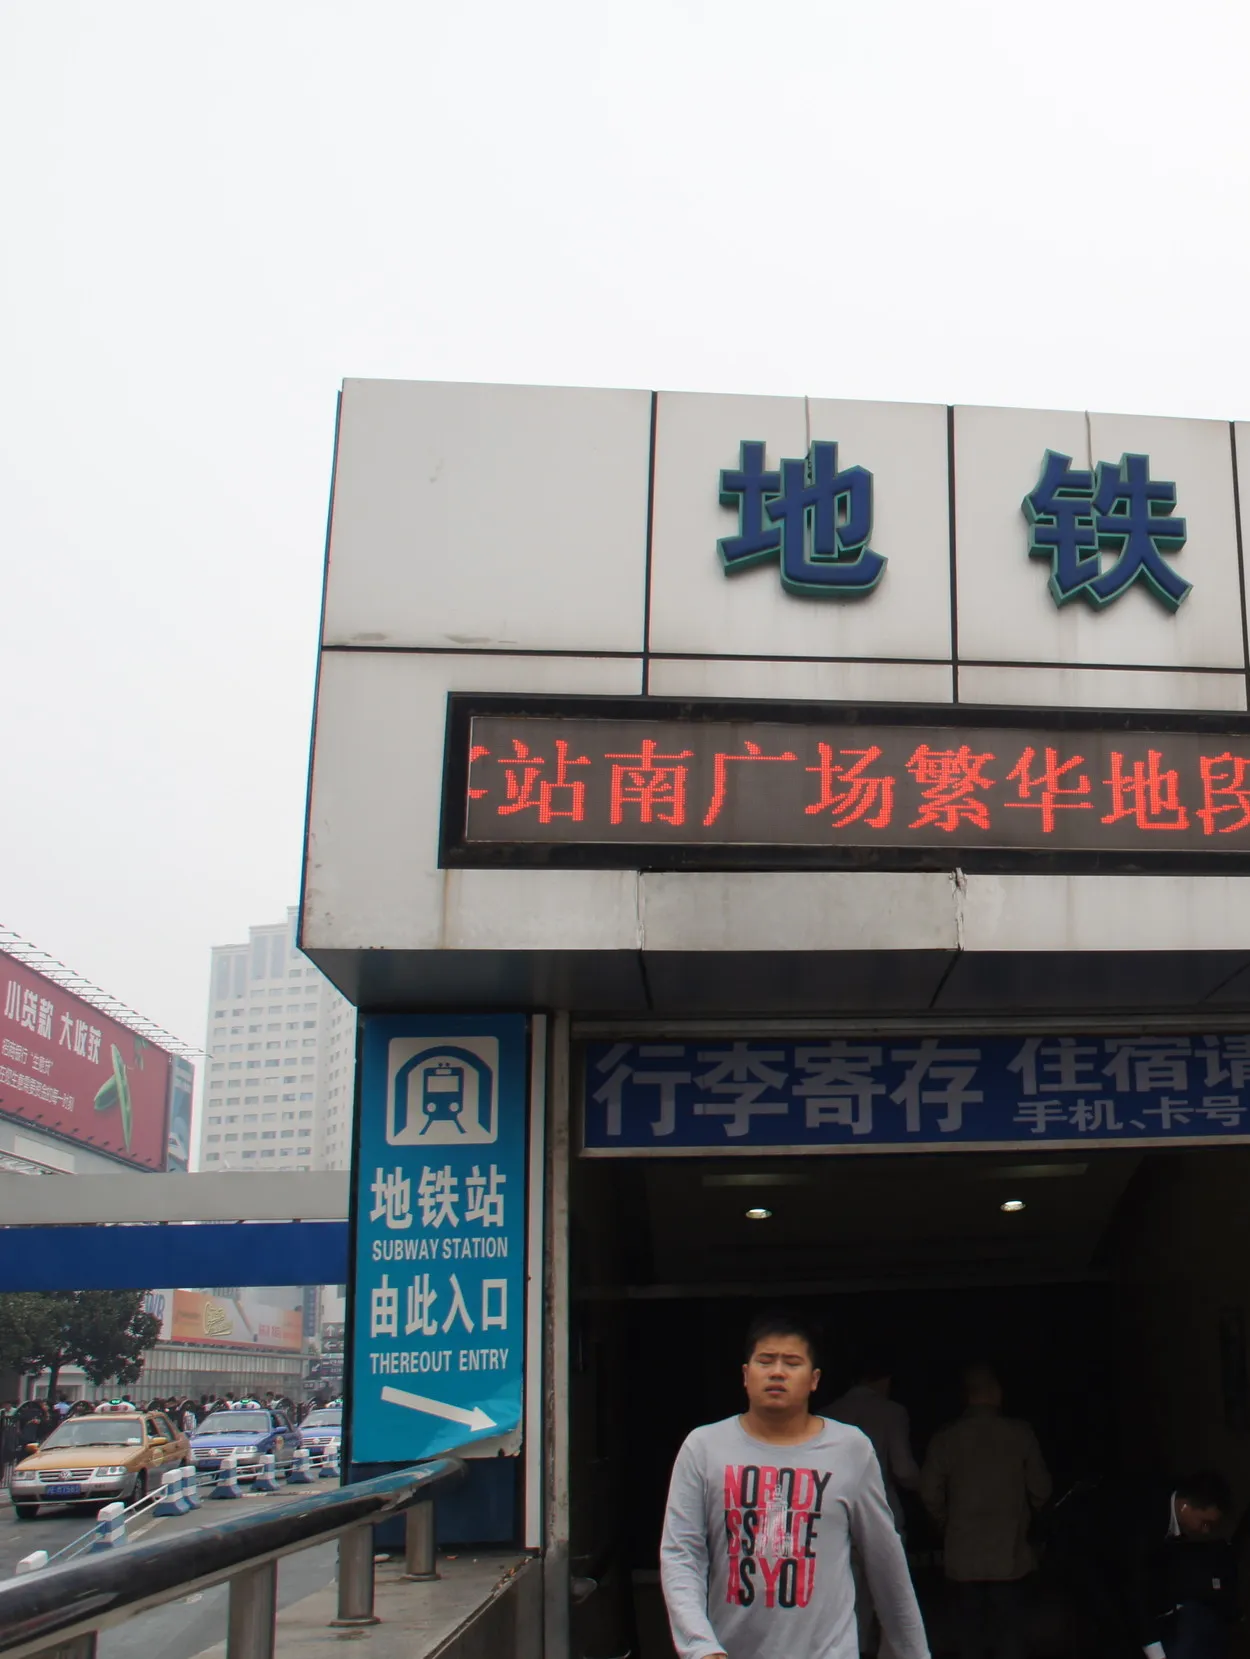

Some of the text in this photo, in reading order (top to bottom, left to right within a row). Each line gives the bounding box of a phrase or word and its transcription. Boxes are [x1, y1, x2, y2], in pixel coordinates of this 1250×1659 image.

[592, 1040, 983, 1137] 行李寄存
[370, 1164, 507, 1229] 地铁站
[372, 1236, 508, 1261] SUBWAY STATION
[370, 1273, 508, 1338] 由此入口
[369, 1350, 453, 1375] THEREOUT
[459, 1348, 509, 1372] ENTRY
[724, 1464, 832, 1512] NOBODY
[726, 1555, 817, 1609] AS YOU
